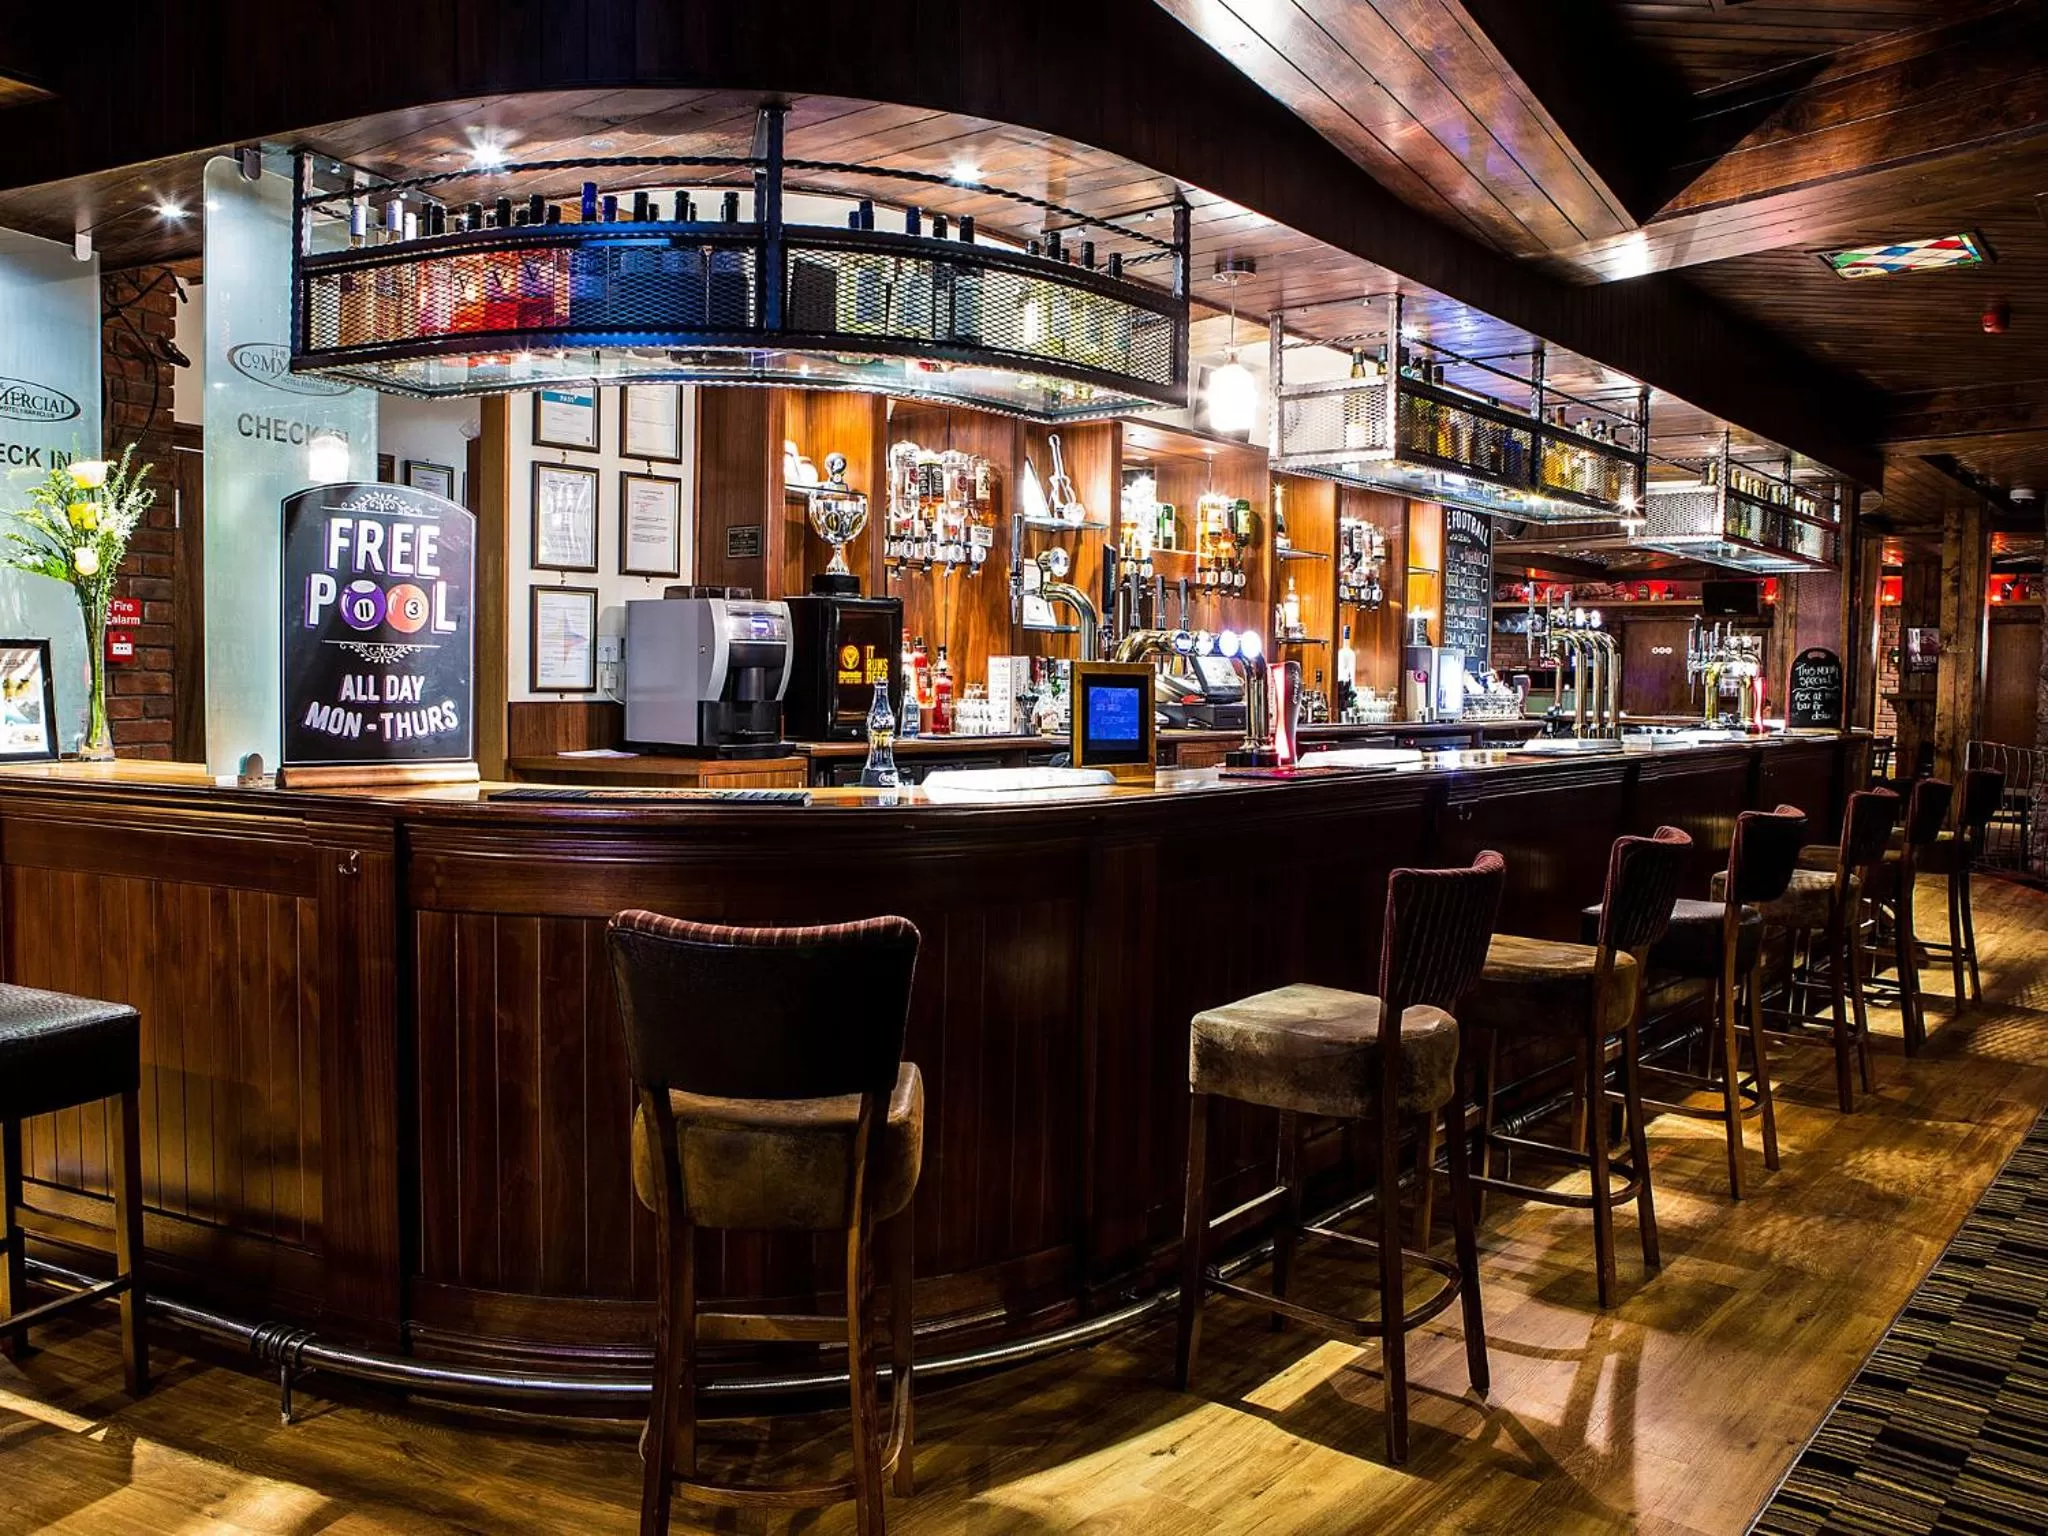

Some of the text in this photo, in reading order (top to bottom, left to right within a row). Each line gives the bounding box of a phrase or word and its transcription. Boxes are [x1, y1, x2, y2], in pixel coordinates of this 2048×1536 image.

[1452, 510, 1489, 547] FOOTBALL
[325, 517, 442, 579] FREE
[112, 613, 141, 625] alarm
[113, 600, 134, 612] Fire
[866, 658, 889, 672] RUNS
[340, 674, 425, 704] ALL DAY
[303, 701, 363, 739] MON
[380, 700, 460, 742] THURS
